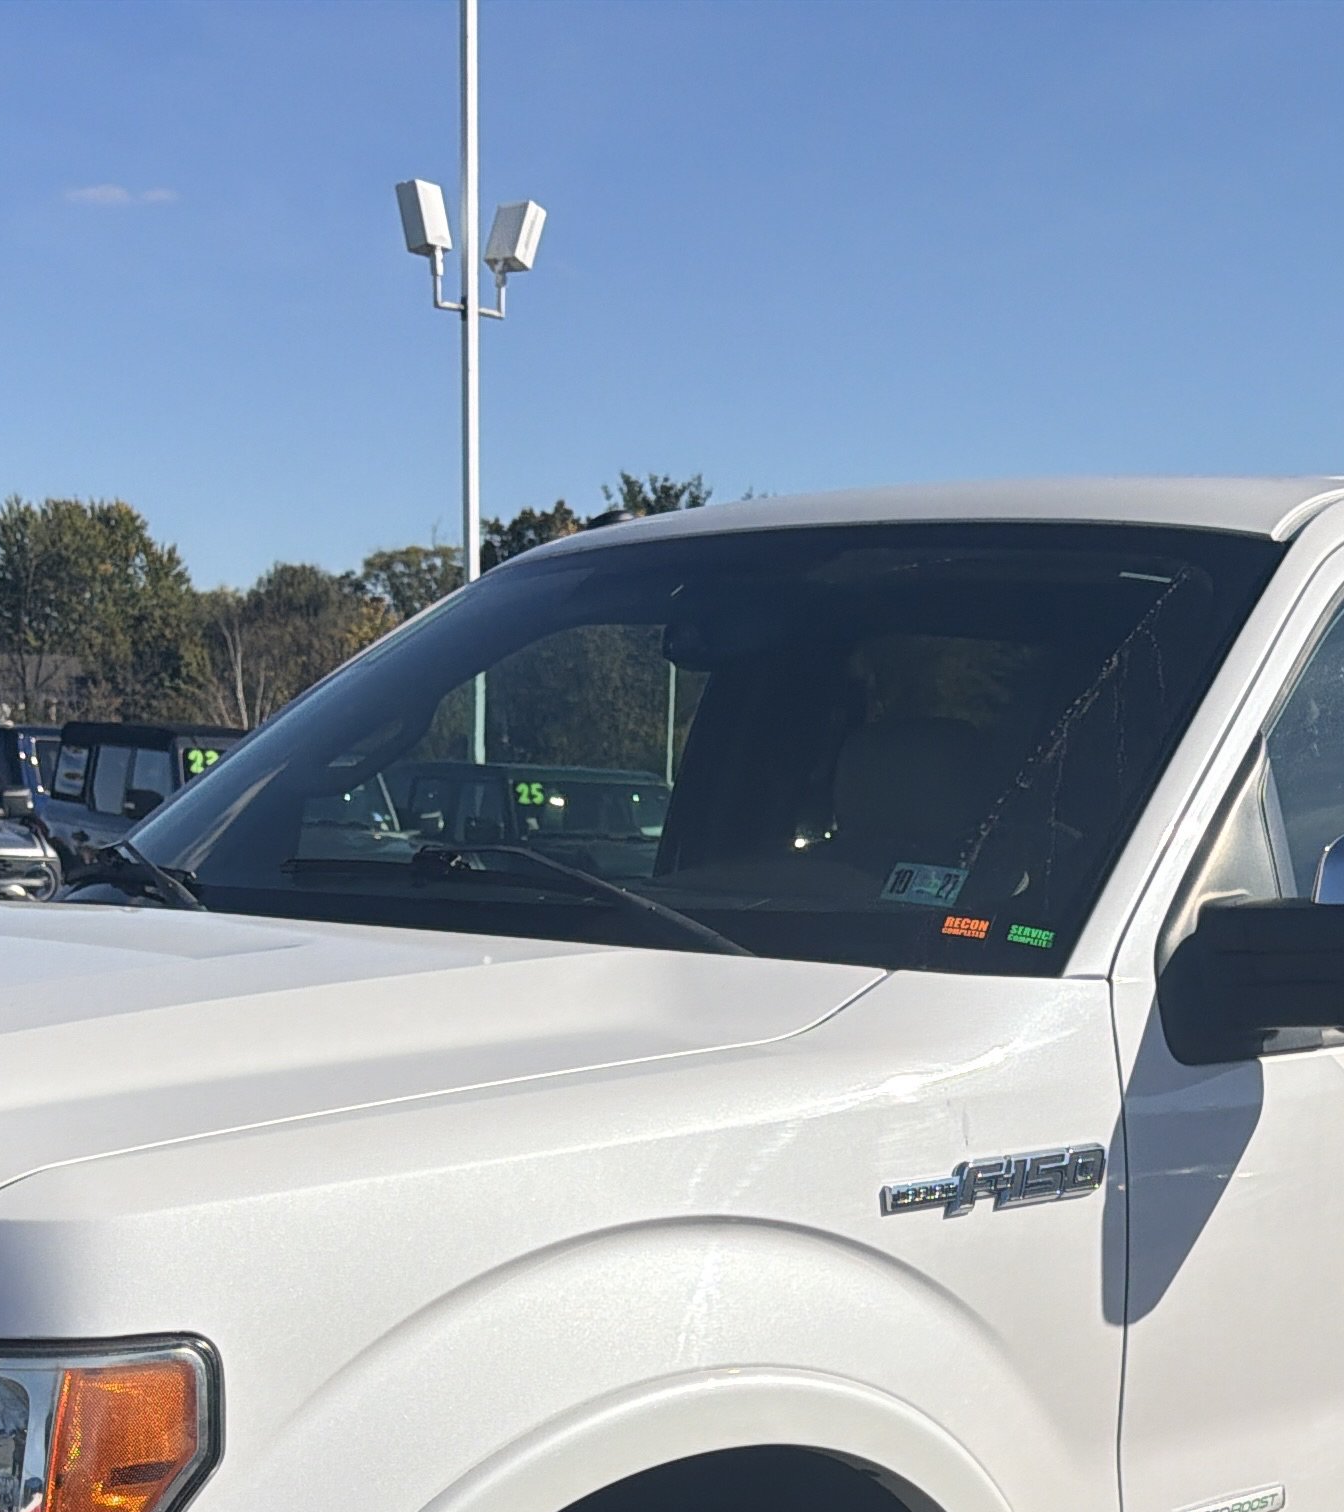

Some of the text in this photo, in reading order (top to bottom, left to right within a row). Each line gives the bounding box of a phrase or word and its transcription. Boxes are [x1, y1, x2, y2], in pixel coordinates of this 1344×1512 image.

[516, 782, 544, 805] 25
[944, 916, 990, 932] RECON
[1009, 924, 1054, 941] SERVICE
